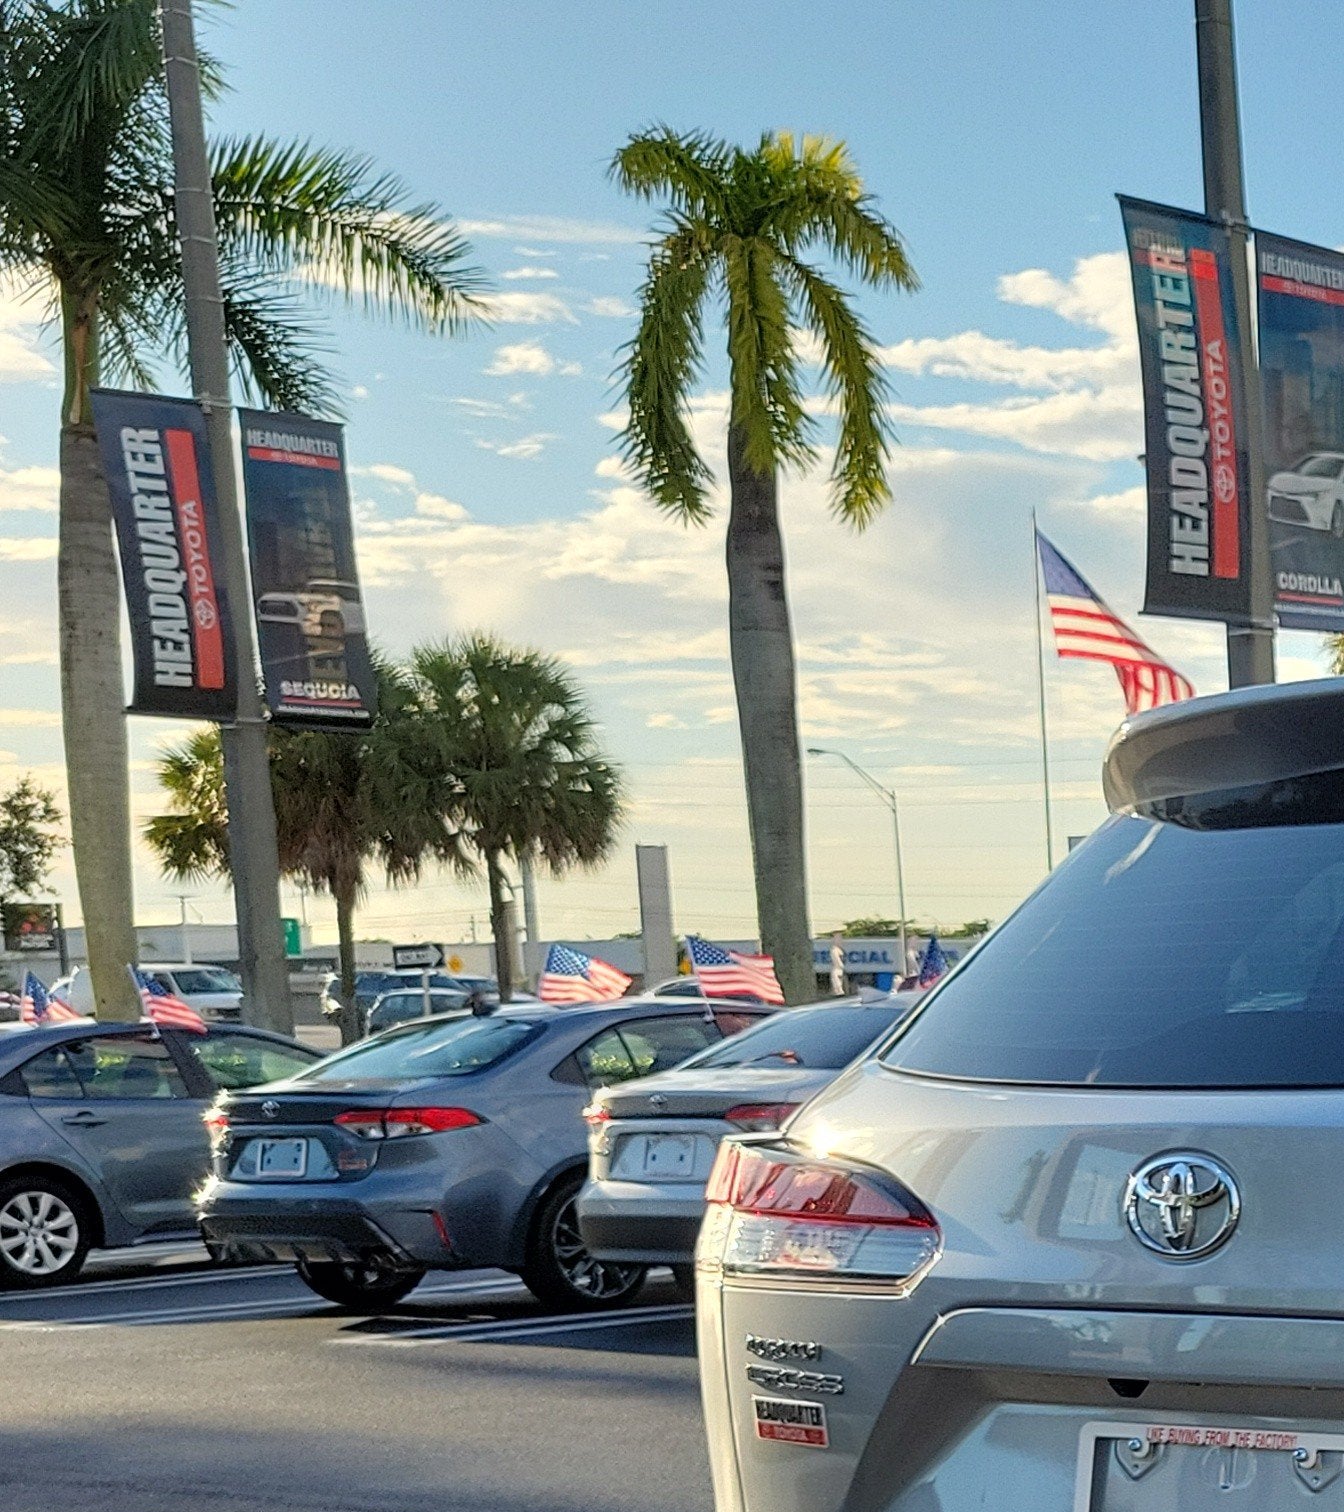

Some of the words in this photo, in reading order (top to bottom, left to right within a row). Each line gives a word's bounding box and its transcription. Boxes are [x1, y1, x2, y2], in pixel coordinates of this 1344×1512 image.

[1150, 245, 1210, 577] HEADQUARTER
[1207, 339, 1232, 461] TOYOTA
[246, 428, 339, 458] HEADQUARTER
[120, 426, 194, 688] HEADQUARTER
[180, 500, 211, 595] TOYOTA
[1276, 571, 1344, 596] COROLLA
[279, 680, 362, 701] SEQUOIA
[1205, 1430, 1231, 1445] FROM
[1235, 1431, 1251, 1446] THE
